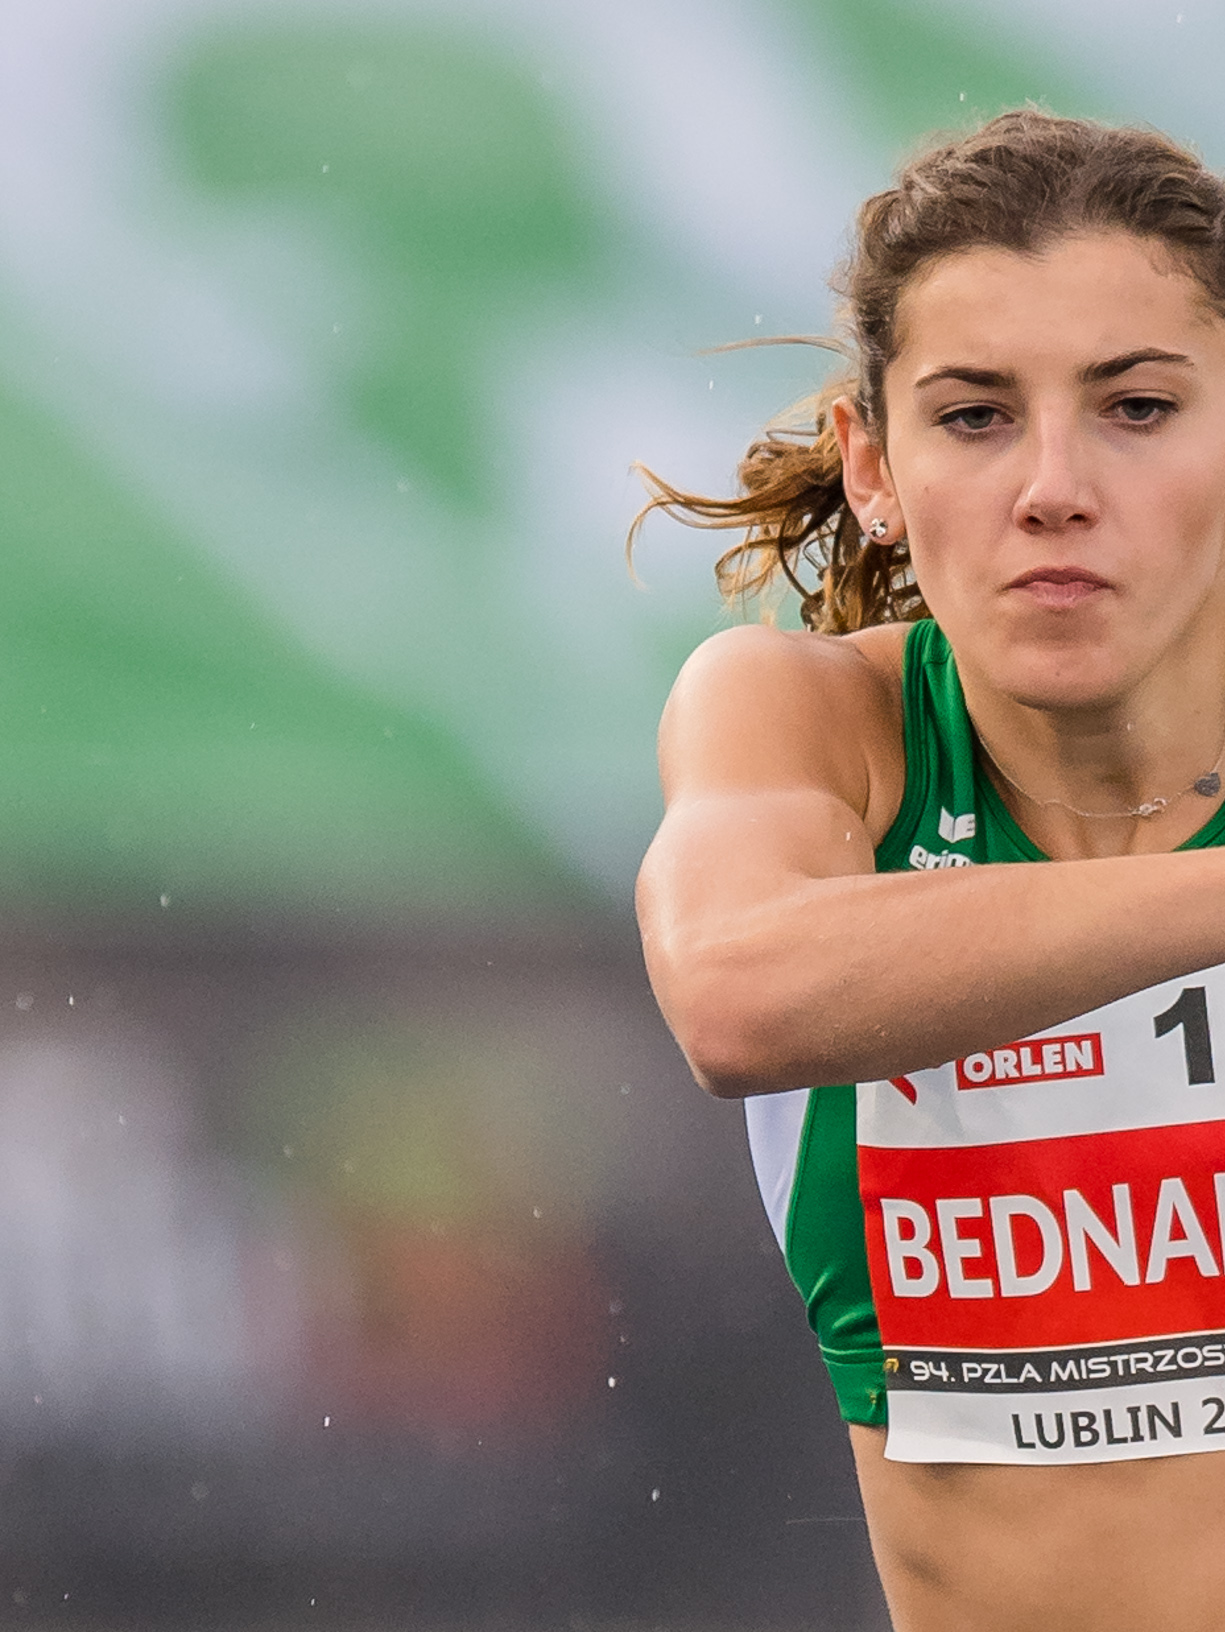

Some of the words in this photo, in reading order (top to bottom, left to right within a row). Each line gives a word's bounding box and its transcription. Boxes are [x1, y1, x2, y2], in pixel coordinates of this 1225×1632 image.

[962, 1040, 1095, 1083] ORLEN
[910, 1360, 955, 1382] 94.
[962, 1362, 1042, 1384] PZLA
[1011, 1401, 1184, 1450] LUBLIN
